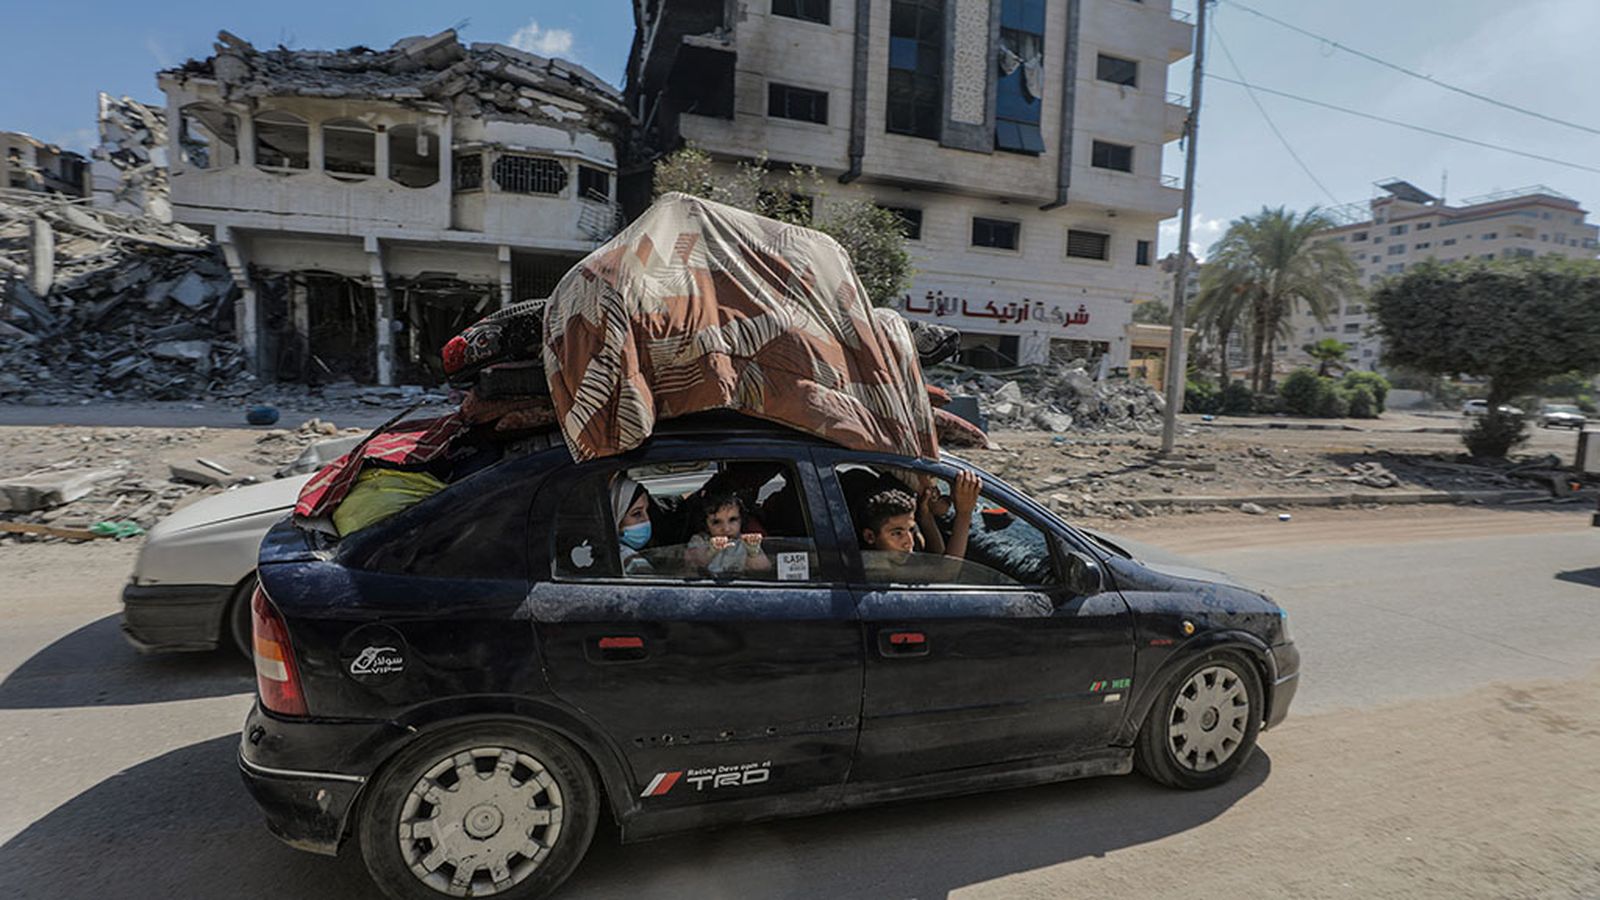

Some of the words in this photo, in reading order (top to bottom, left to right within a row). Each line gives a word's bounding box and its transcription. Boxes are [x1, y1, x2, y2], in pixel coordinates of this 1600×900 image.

[1032, 301, 1089, 327] شركة
[1101, 678, 1131, 689] PWER
[687, 768, 717, 776] Racing
[687, 768, 769, 790] TRD
